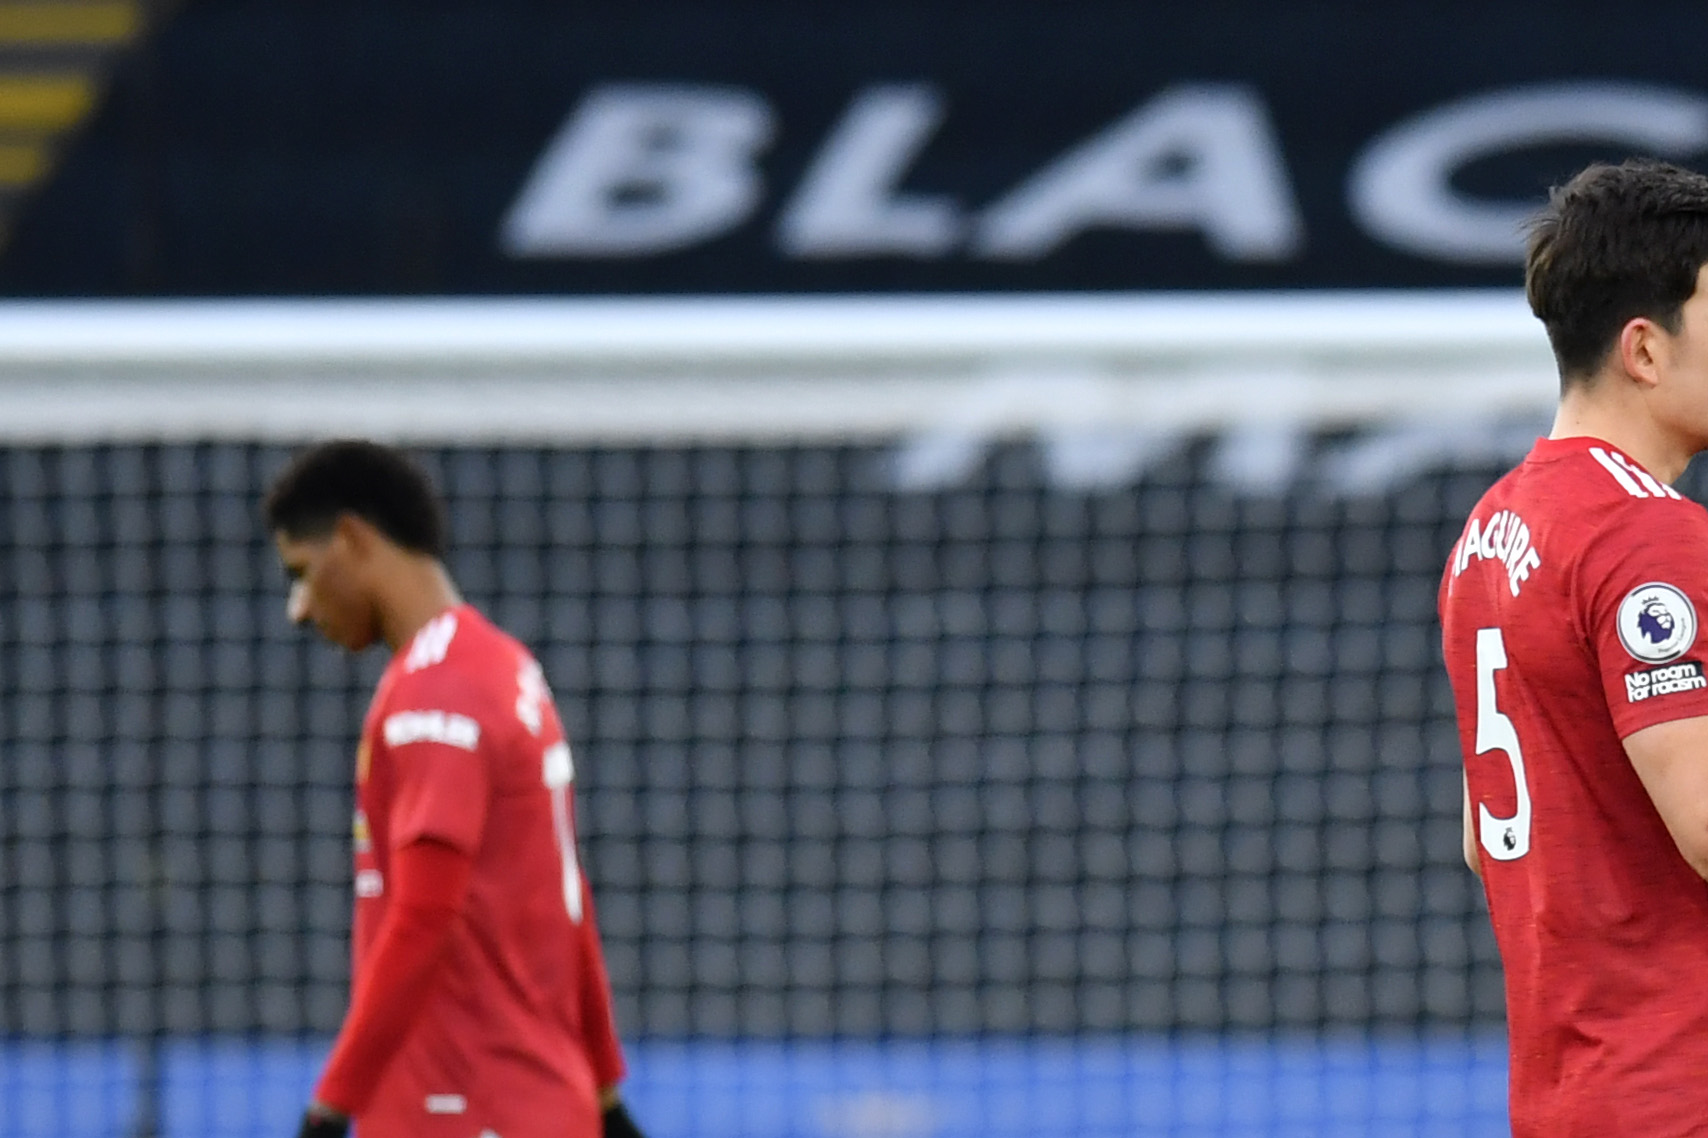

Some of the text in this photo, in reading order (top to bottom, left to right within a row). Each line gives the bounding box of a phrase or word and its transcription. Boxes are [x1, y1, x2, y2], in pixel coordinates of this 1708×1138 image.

[1624, 664, 1697, 689] No room
[1475, 628, 1532, 861] 5
